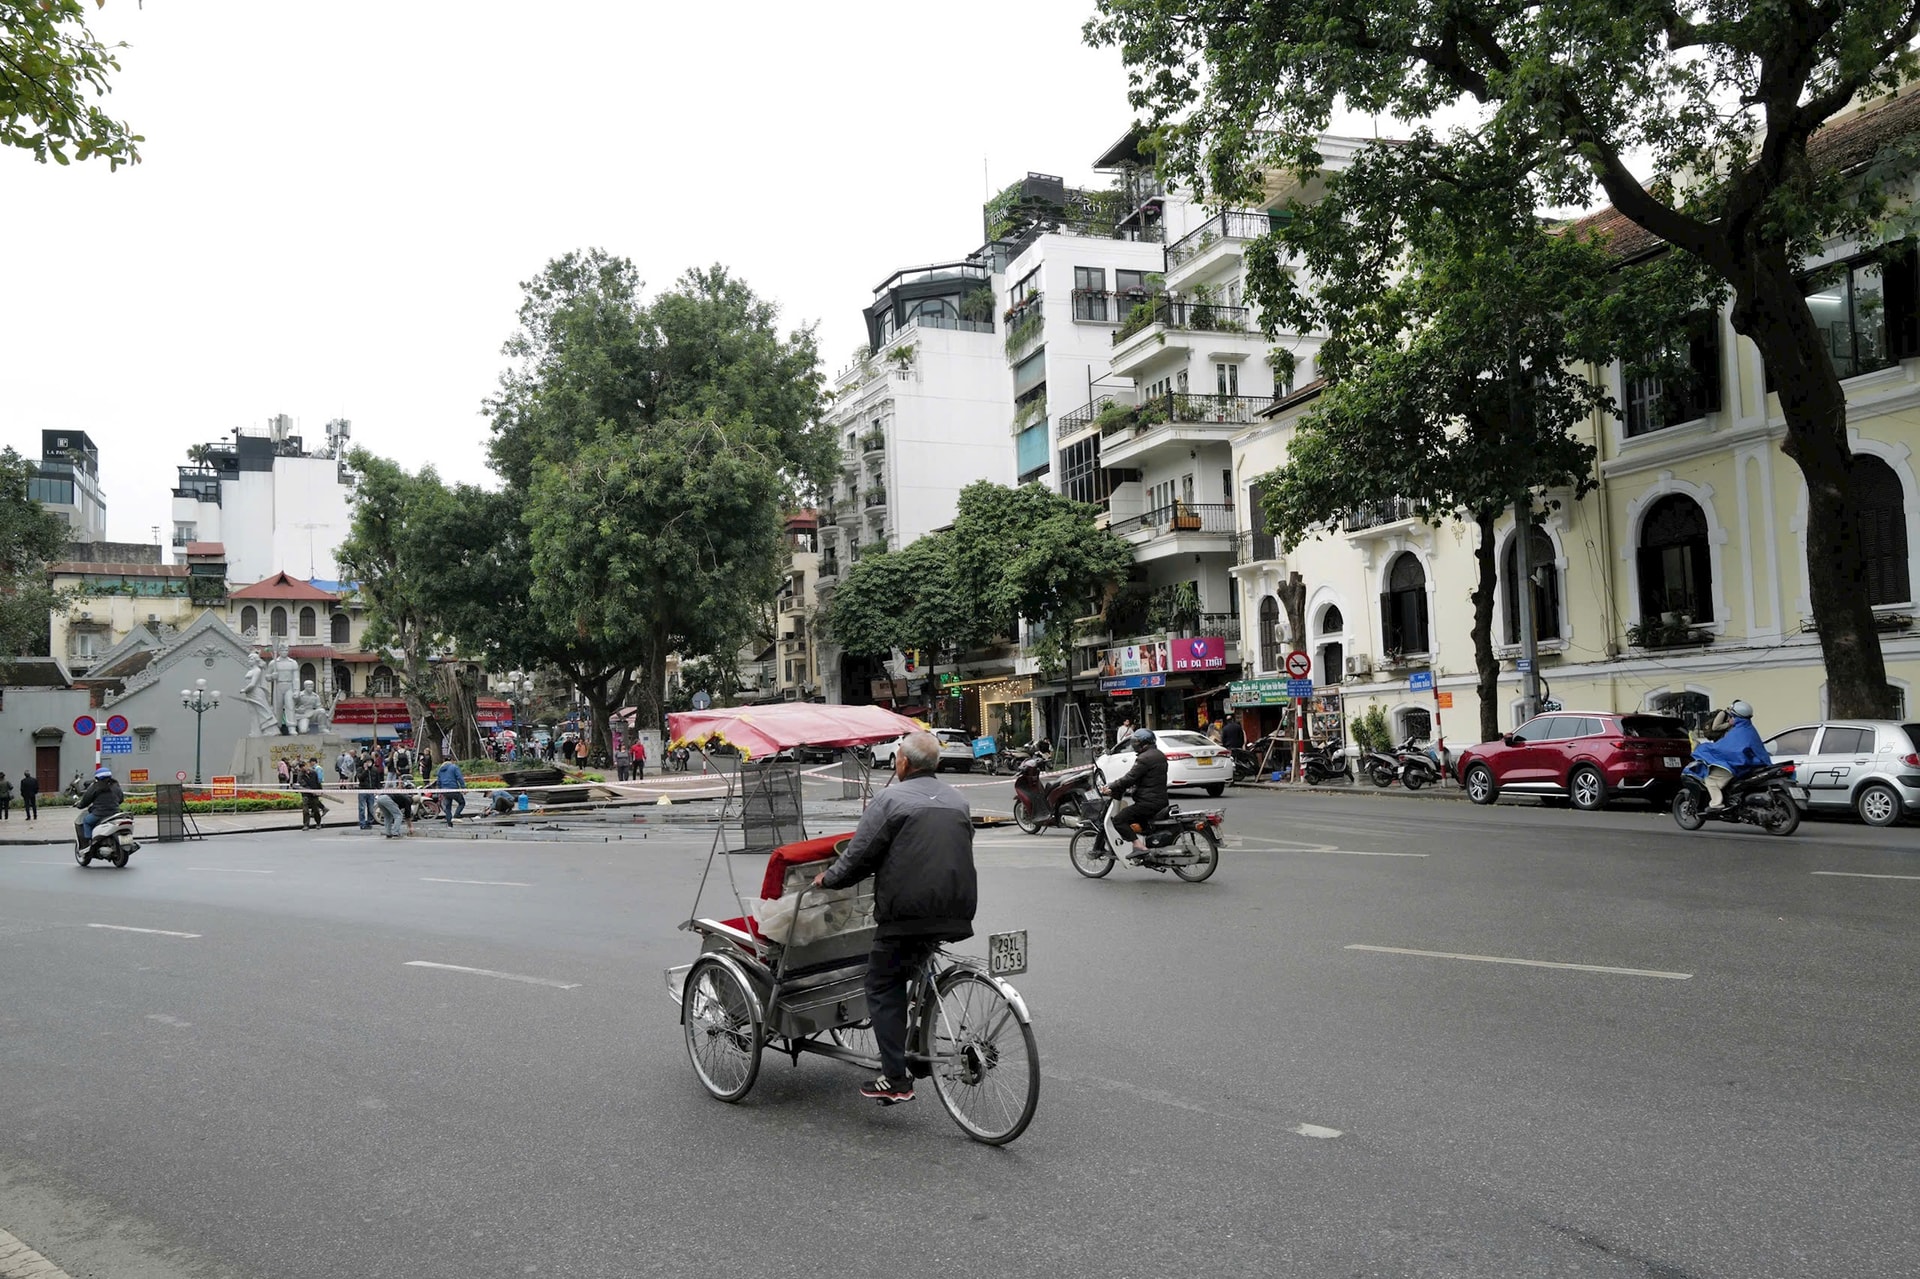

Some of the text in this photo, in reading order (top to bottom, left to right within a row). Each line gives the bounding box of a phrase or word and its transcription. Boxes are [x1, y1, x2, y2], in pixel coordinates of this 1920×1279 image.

[1205, 656, 1223, 668] THẬT
[998, 937, 1019, 953] 29XL
[995, 952, 1022, 970] 0259
